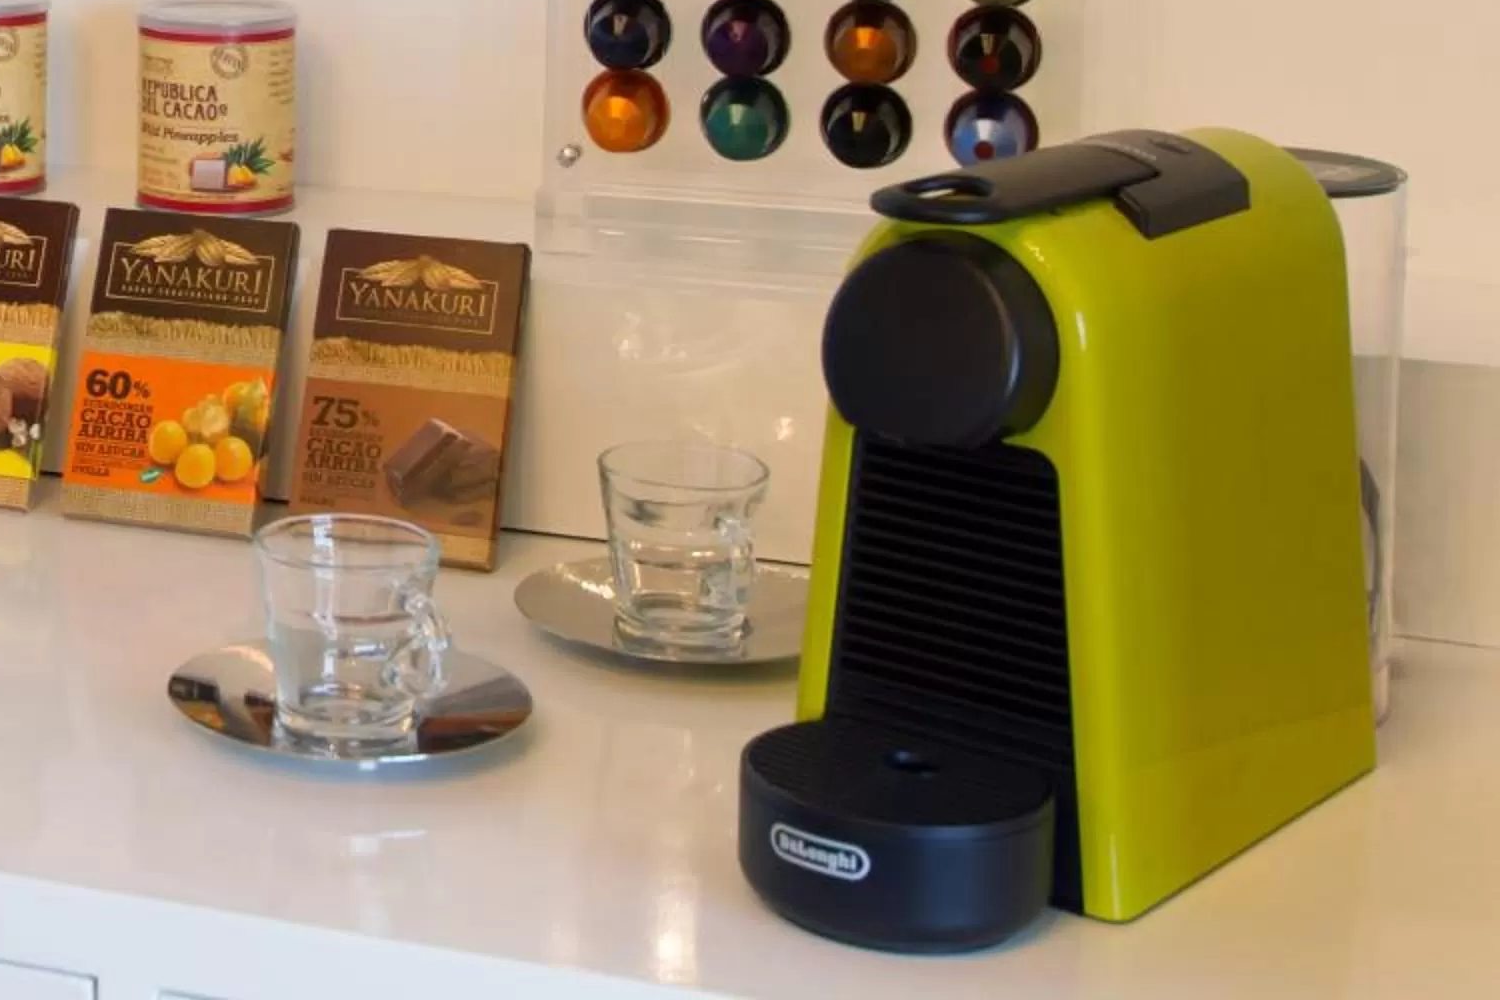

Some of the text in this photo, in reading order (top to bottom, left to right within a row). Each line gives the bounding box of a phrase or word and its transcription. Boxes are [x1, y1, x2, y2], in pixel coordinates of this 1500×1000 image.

[163, 126, 239, 146] Pineapples
[120, 256, 263, 295] YANAKURI
[349, 281, 487, 317] YANAKURI
[85, 368, 151, 400] 60%
[80, 407, 152, 429] CACAO
[311, 396, 380, 430] 75%
[77, 423, 149, 445] ARRIBA
[306, 437, 382, 459] CACAO
[303, 450, 380, 475] ARRIBA
